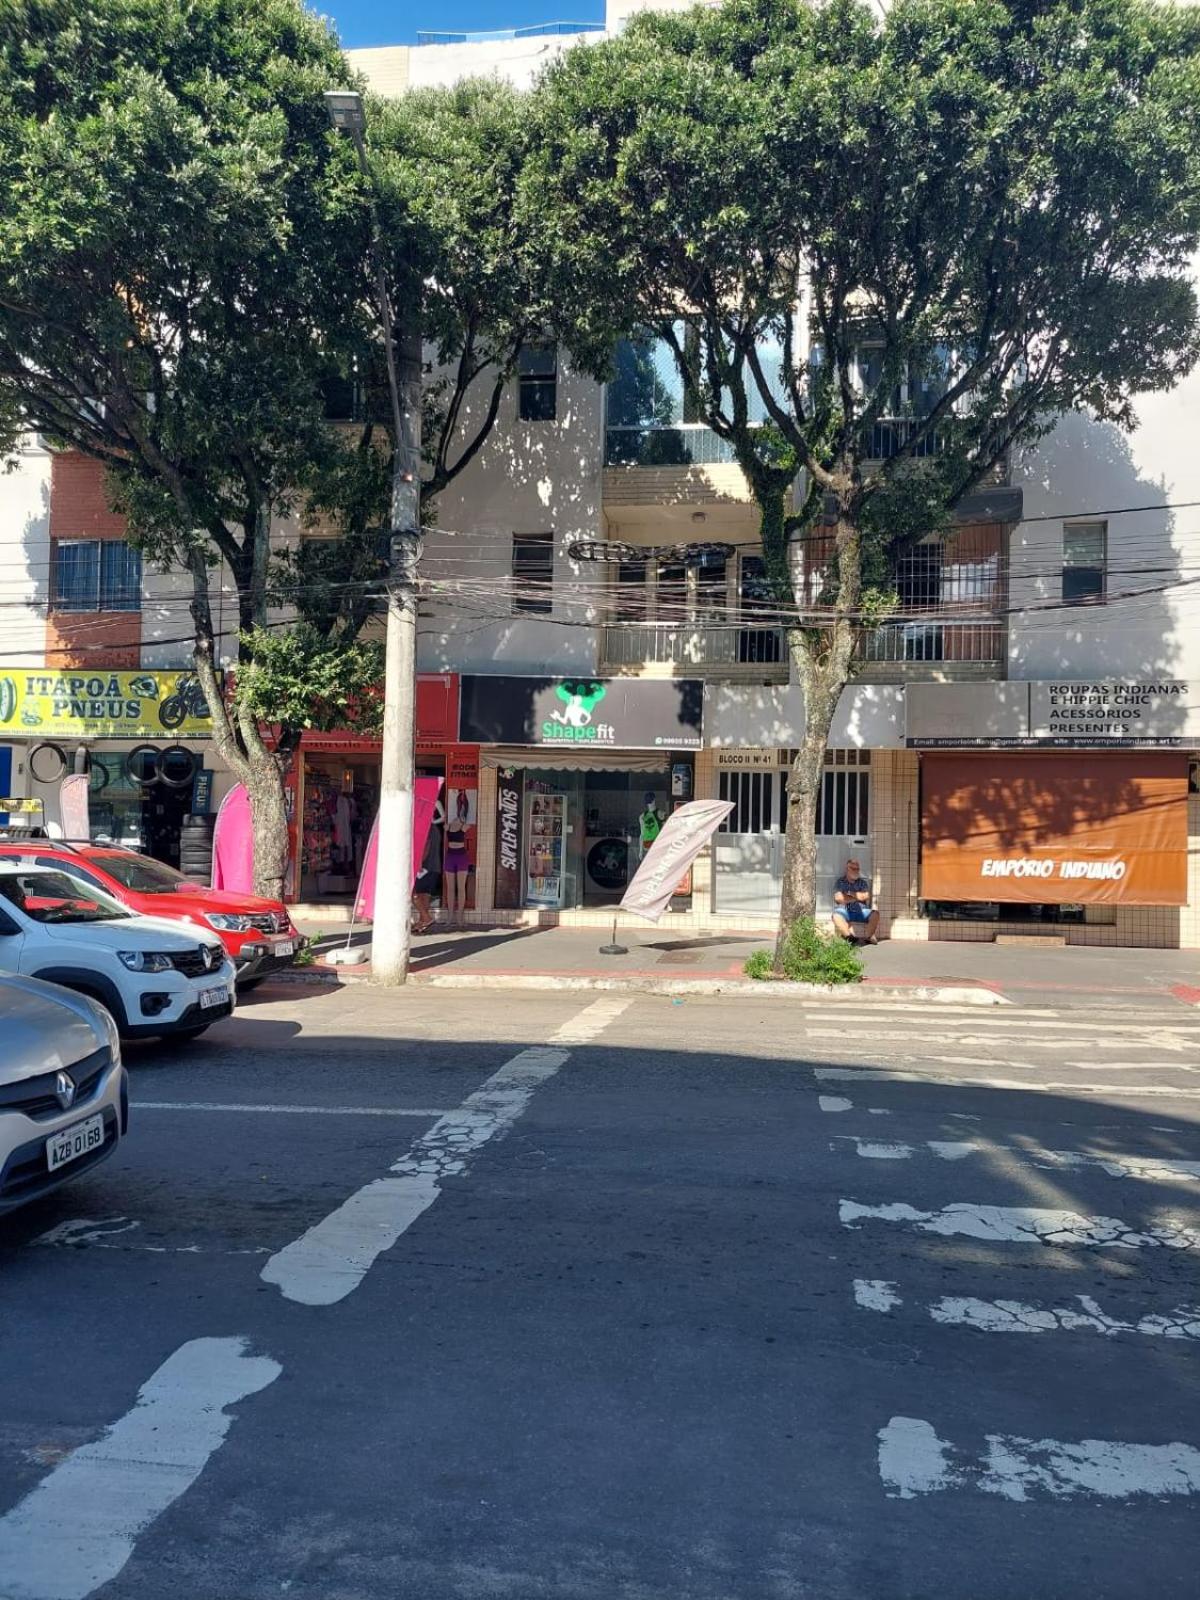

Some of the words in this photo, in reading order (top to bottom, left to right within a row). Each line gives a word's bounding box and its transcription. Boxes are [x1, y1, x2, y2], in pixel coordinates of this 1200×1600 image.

[26, 675, 123, 698] ITAPOÃ
[1049, 685, 1109, 695] ROUPAS
[1113, 685, 1189, 695] INDIANAS
[52, 699, 142, 719] PNEUS
[1051, 695, 1058, 705] E
[1063, 695, 1110, 705] HIPPIE
[1114, 695, 1150, 705] CHIC
[1049, 723, 1129, 733] PRESENTES
[719, 755, 743, 764] BLOCO
[763, 756, 771, 764] 41
[499, 787, 519, 871] SUPLEMENTOS
[981, 857, 1055, 878] EMPÓRIO
[75, 1127, 100, 1153] 0168
